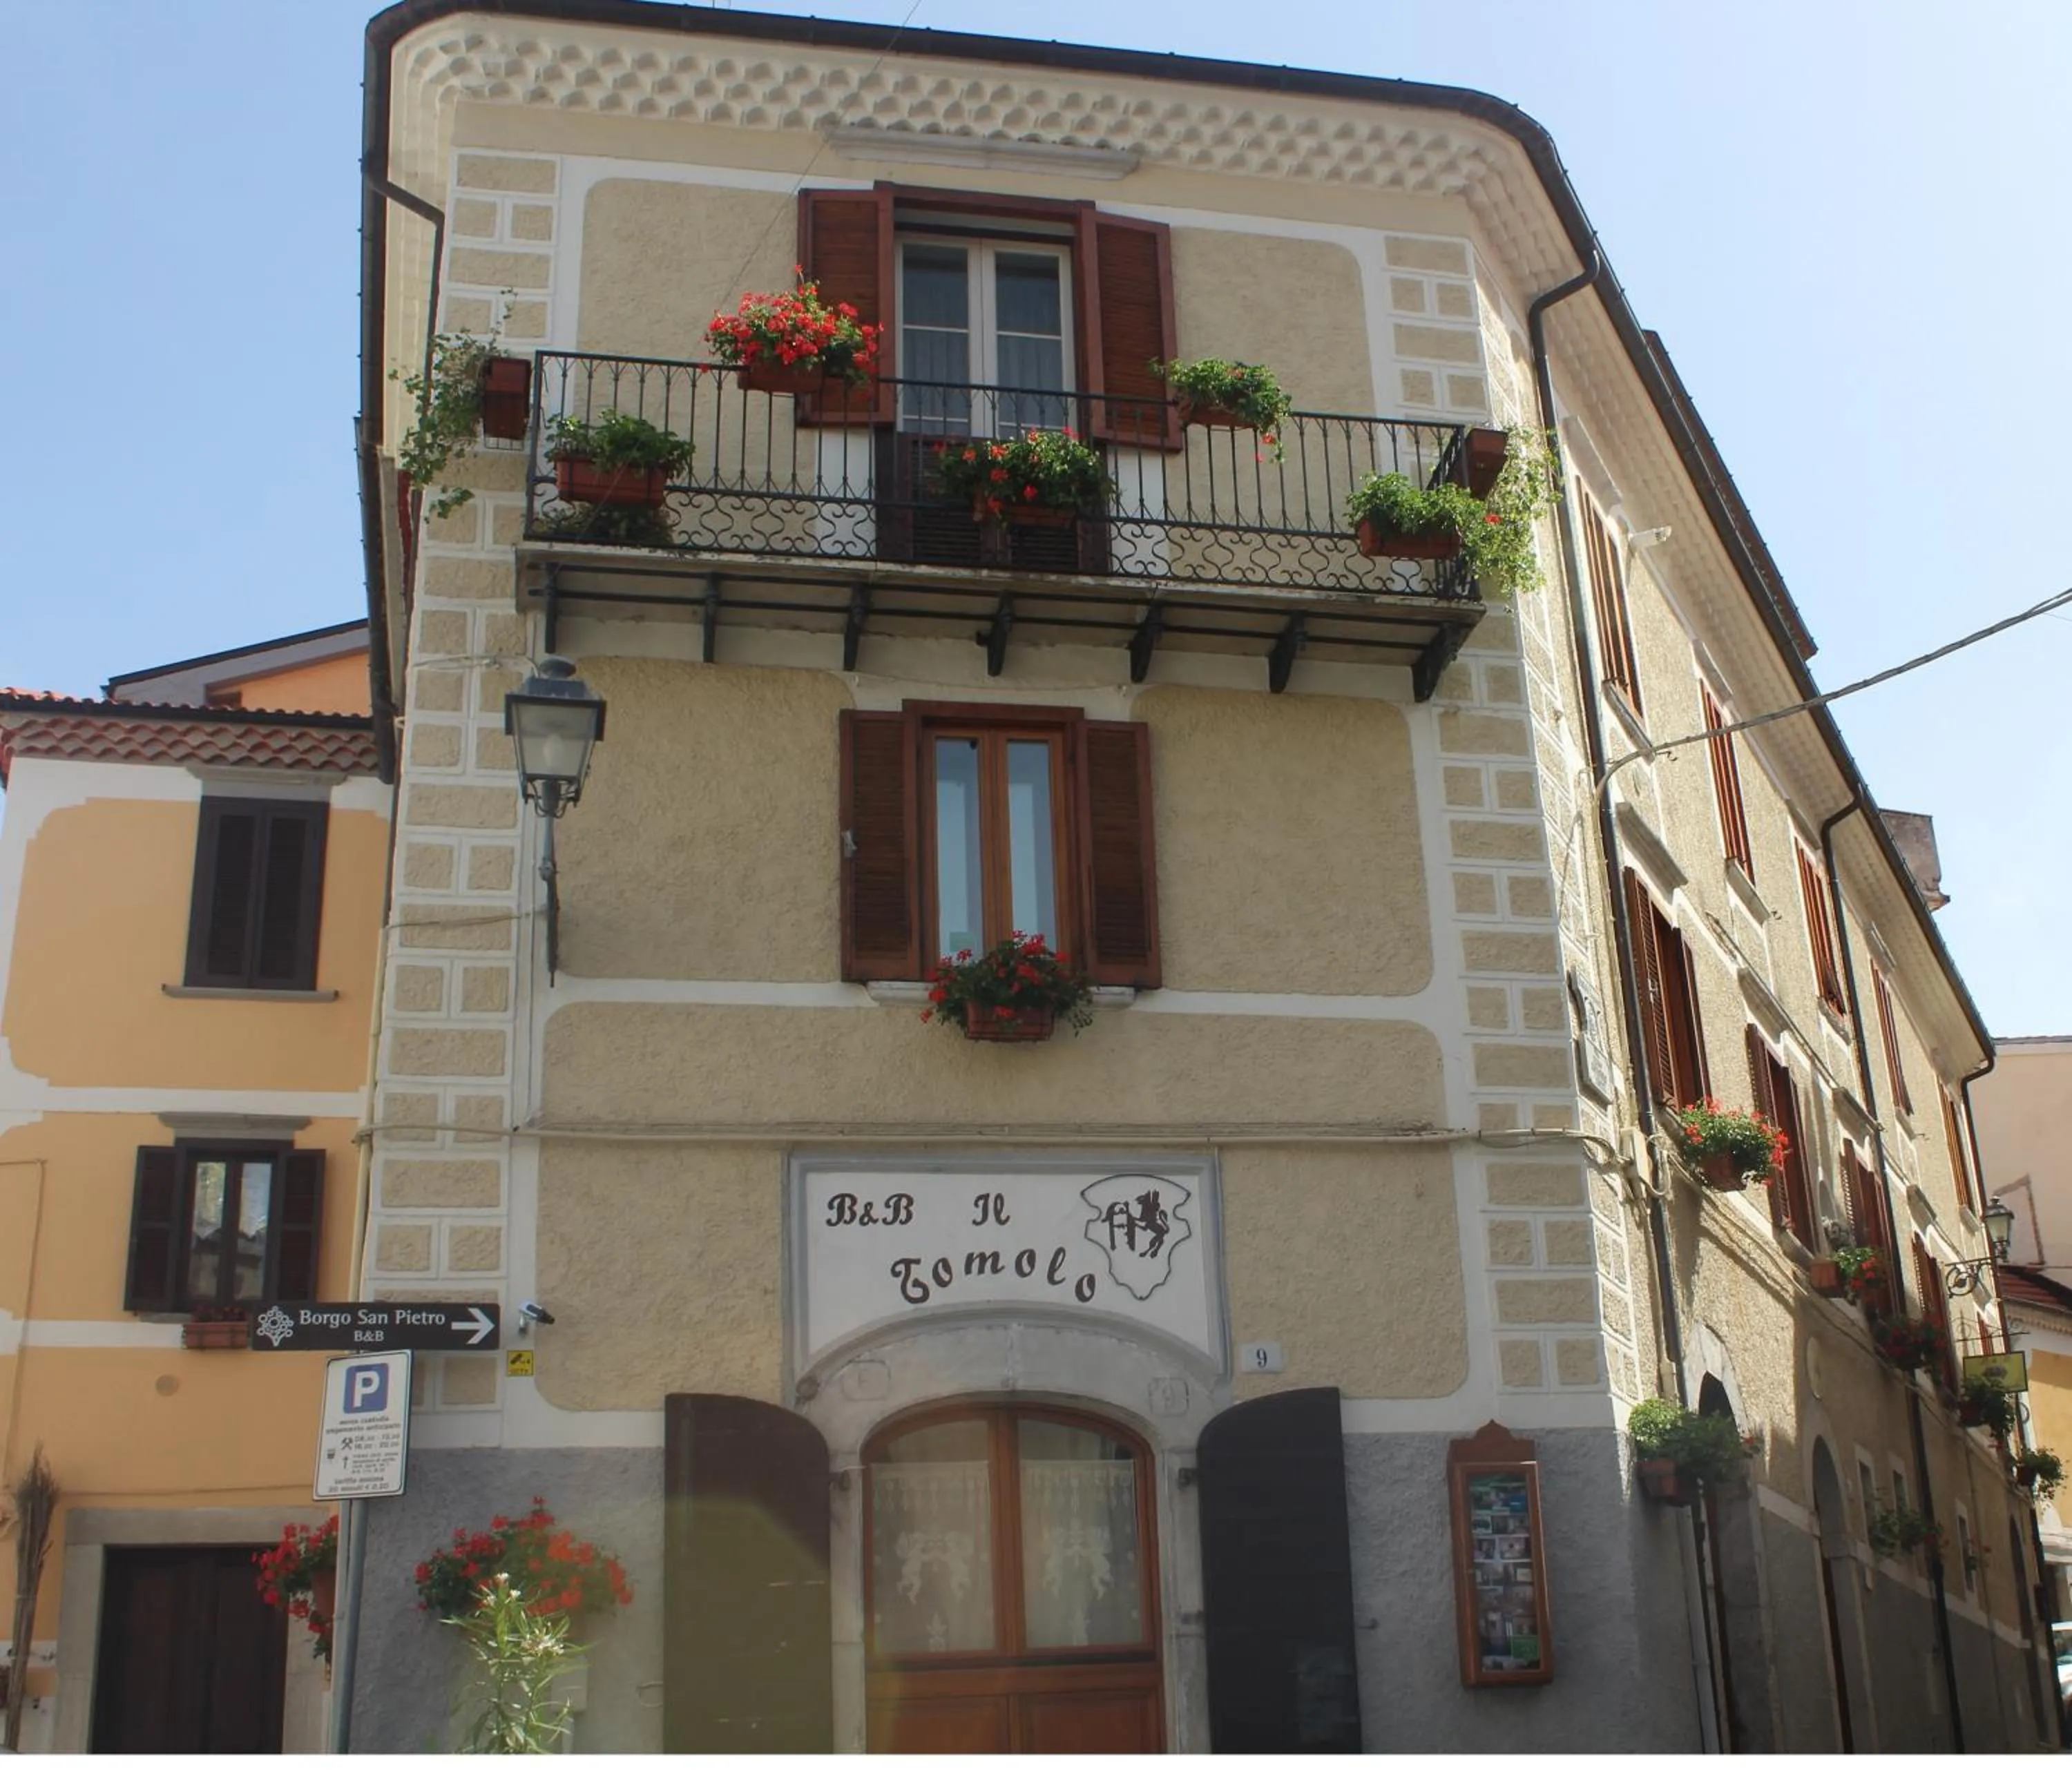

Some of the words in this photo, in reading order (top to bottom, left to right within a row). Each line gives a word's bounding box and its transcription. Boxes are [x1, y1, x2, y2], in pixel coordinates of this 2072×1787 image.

[826, 1192, 914, 1227] B&B
[972, 1192, 1010, 1226] Il
[890, 1246, 1096, 1304] Tomolo
[299, 1309, 352, 1329] Borgo
[357, 1308, 388, 1325] San
[394, 1309, 445, 1325] Pietro
[354, 1329, 385, 1342] B&B
[1256, 1347, 1267, 1369] 9
[353, 1371, 381, 1408] P
